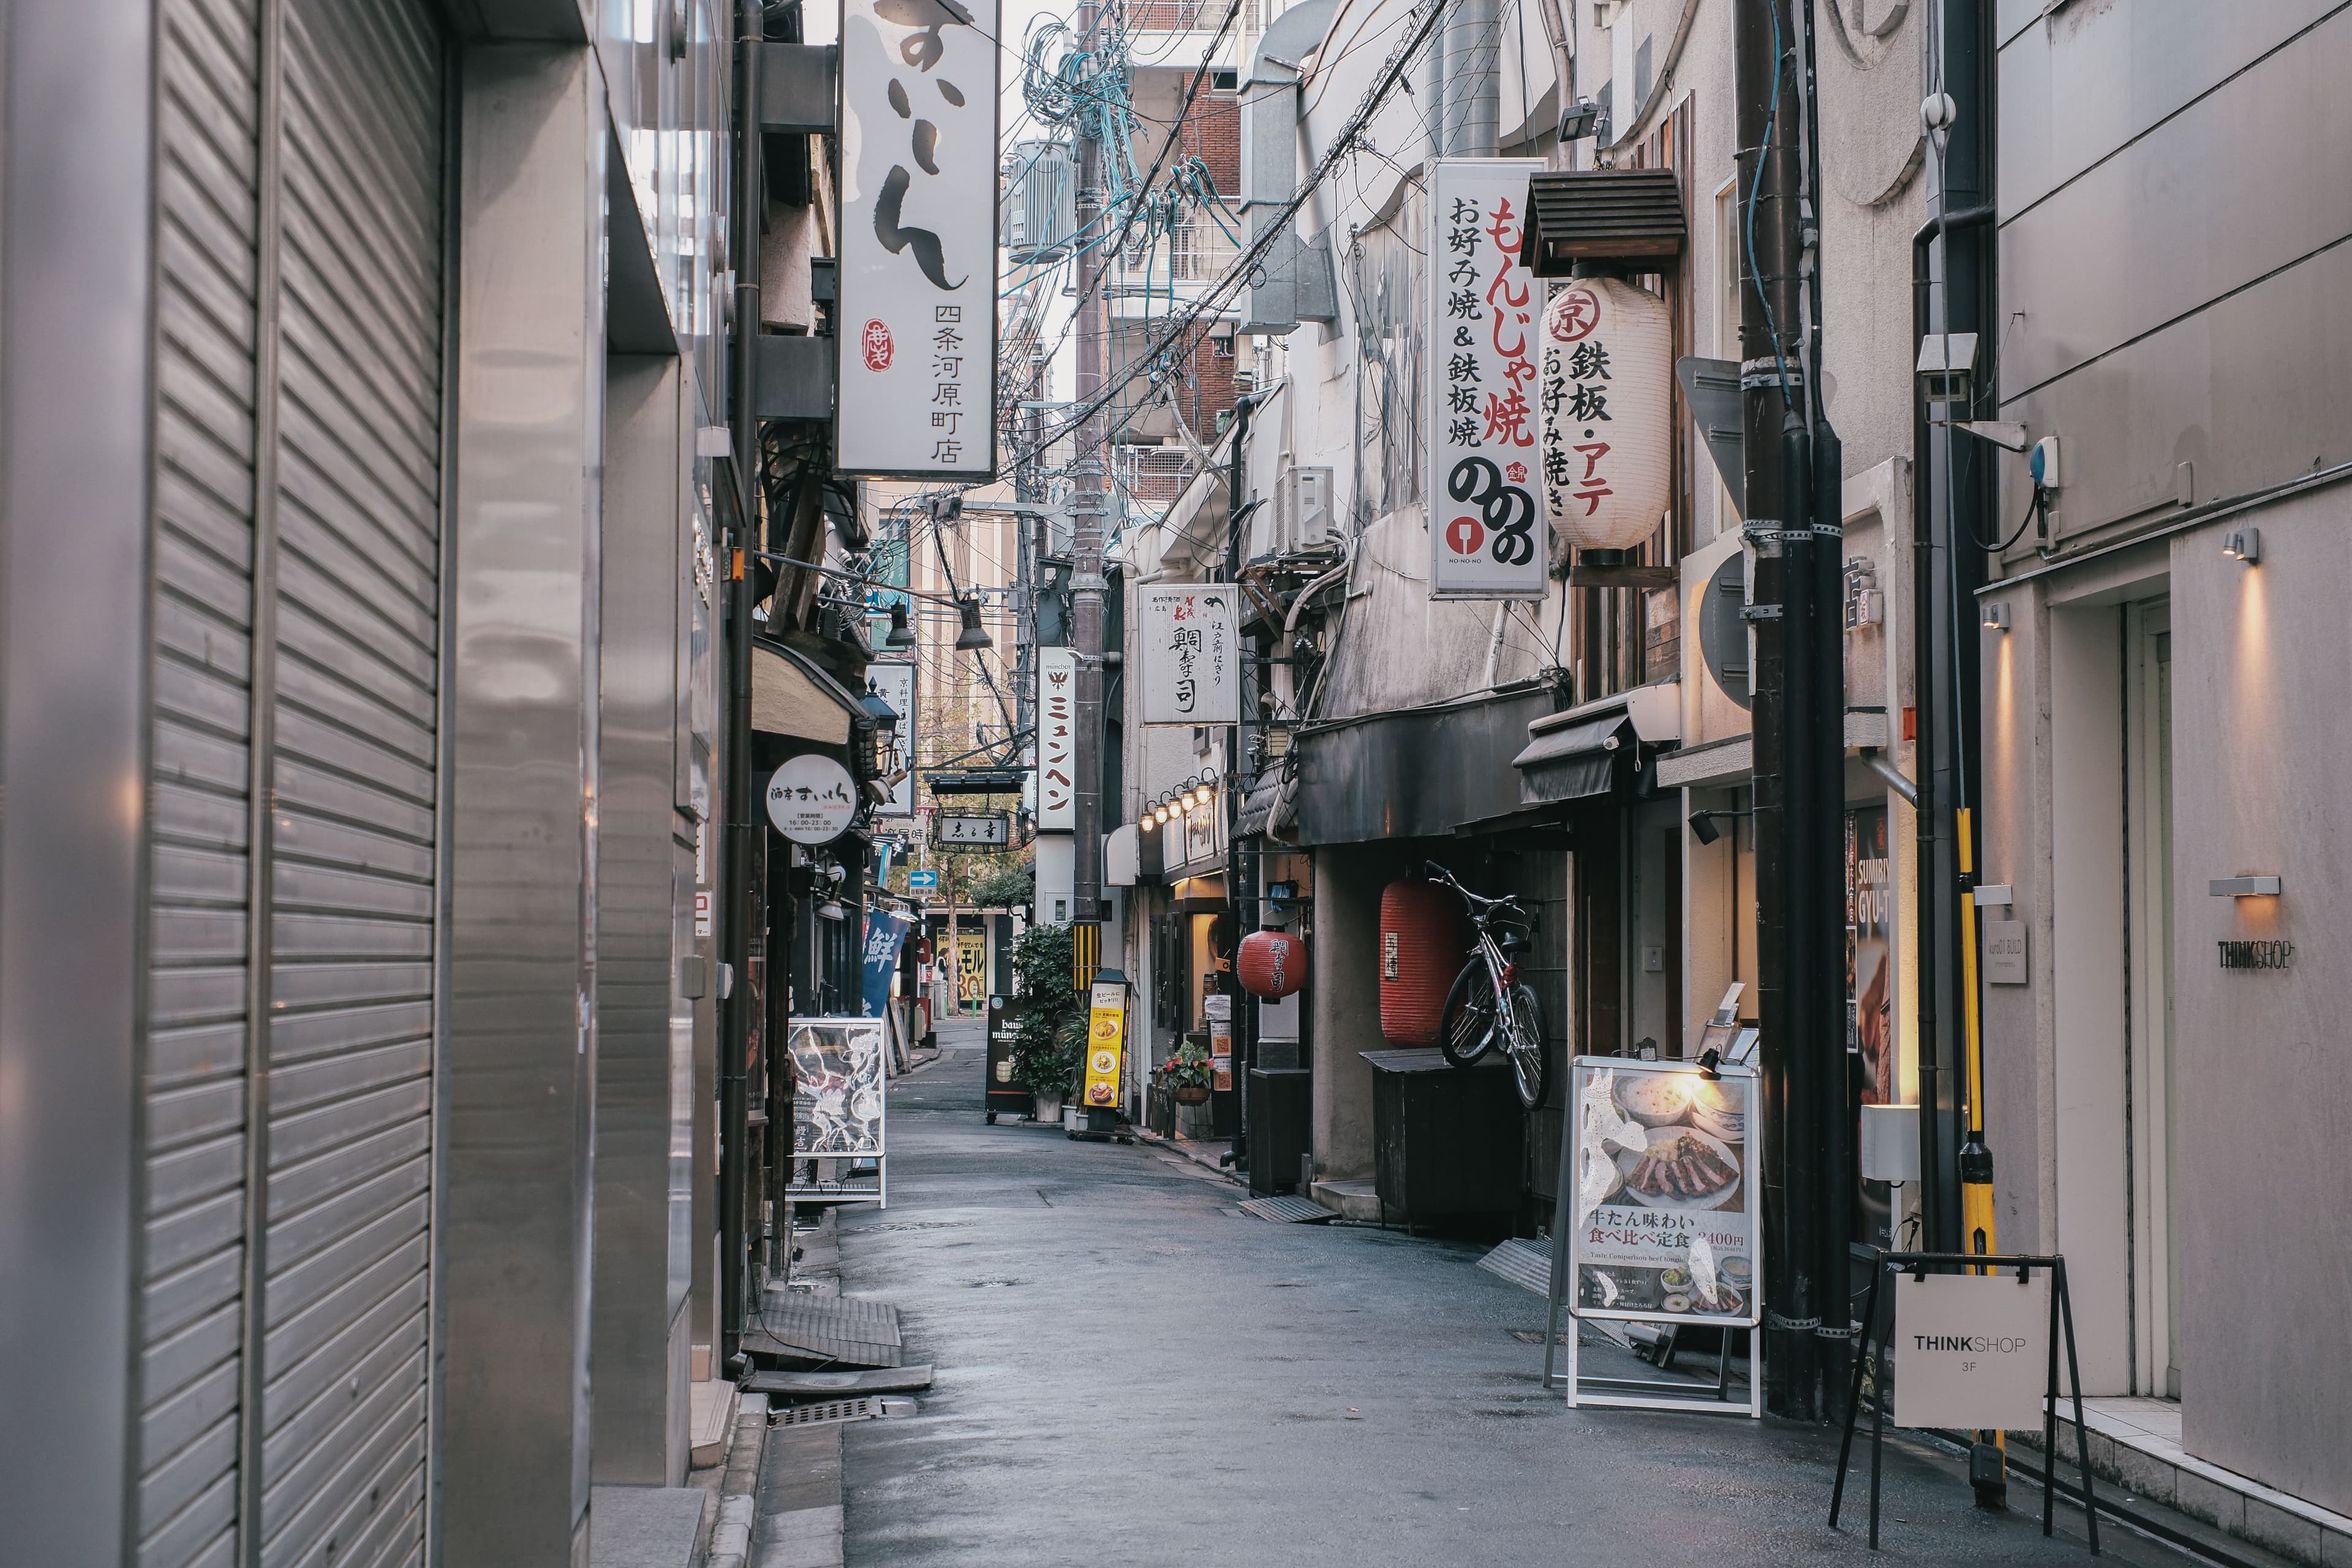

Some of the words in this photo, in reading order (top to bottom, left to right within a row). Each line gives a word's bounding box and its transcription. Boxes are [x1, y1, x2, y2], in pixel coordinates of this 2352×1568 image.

[1447, 197, 1482, 448] お好み焼&鉄板焼
[1483, 197, 1536, 447] もんじゃ焼
[1556, 293, 1592, 333] 京
[931, 306, 963, 463] 四条河原町店
[1540, 347, 1570, 517] お好み焼き
[1567, 341, 1613, 516] 鉄板・アテ
[1212, 621, 1224, 687] 江戸前にぎり
[1044, 696, 1071, 811] ミュンヘン
[951, 821, 997, 840] 志る幸
[957, 949, 984, 974] モル
[2218, 940, 2291, 969] THINKSHOP
[1589, 1209, 1695, 1229] 牛たん味わい
[1588, 1227, 1691, 1248] 食べ比べ定食
[1609, 1253, 1647, 1262] Comparison
[1913, 1335, 2026, 1353] THINKSHOP
[1962, 1362, 1977, 1372] 3F
